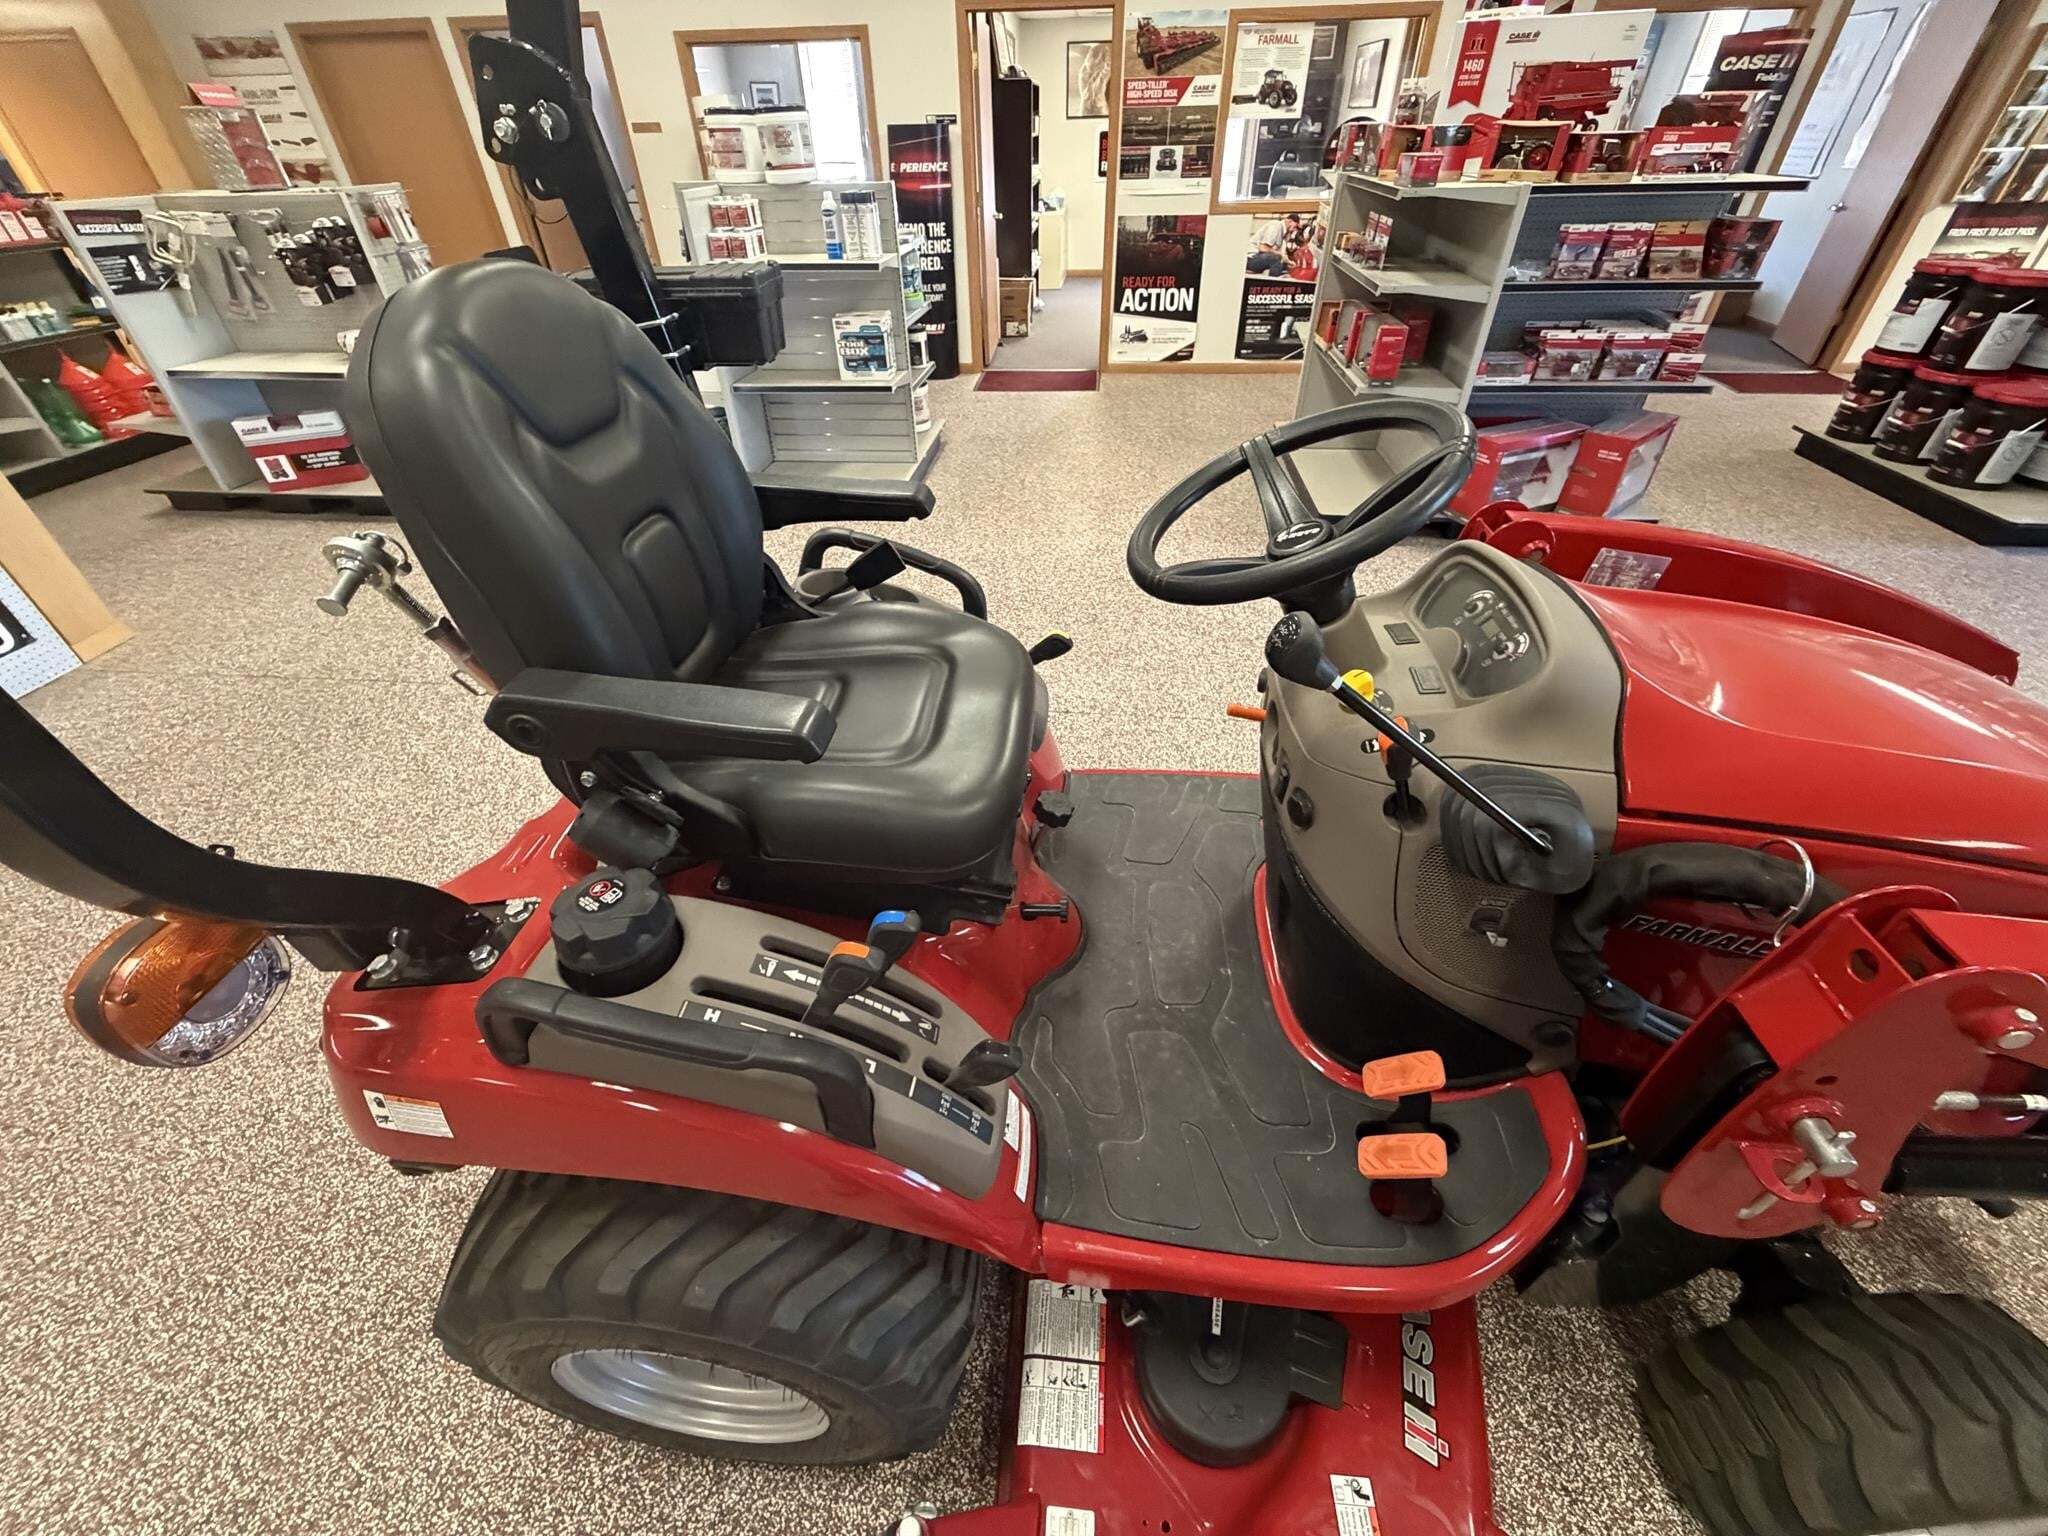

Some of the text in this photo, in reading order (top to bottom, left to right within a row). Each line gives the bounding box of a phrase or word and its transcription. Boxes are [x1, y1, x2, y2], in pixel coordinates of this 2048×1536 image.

[1257, 34, 1299, 46] FARMALL
[1508, 32, 1532, 40] CASE
[1462, 59, 1484, 72] 1460
[1720, 53, 1782, 72] CASE
[1163, 88, 1178, 98] DISK
[890, 161, 949, 173] EPERIENCE
[927, 222, 947, 237] THE
[1967, 227, 1990, 236] FIRST
[1998, 227, 2018, 236] LAST
[1122, 275, 1176, 288] READY FOR
[1119, 287, 1195, 312] ACTION
[1247, 293, 1315, 305] SUCCESSFUL SEAS
[840, 347, 869, 357] BOX
[703, 1007, 722, 1023] H
